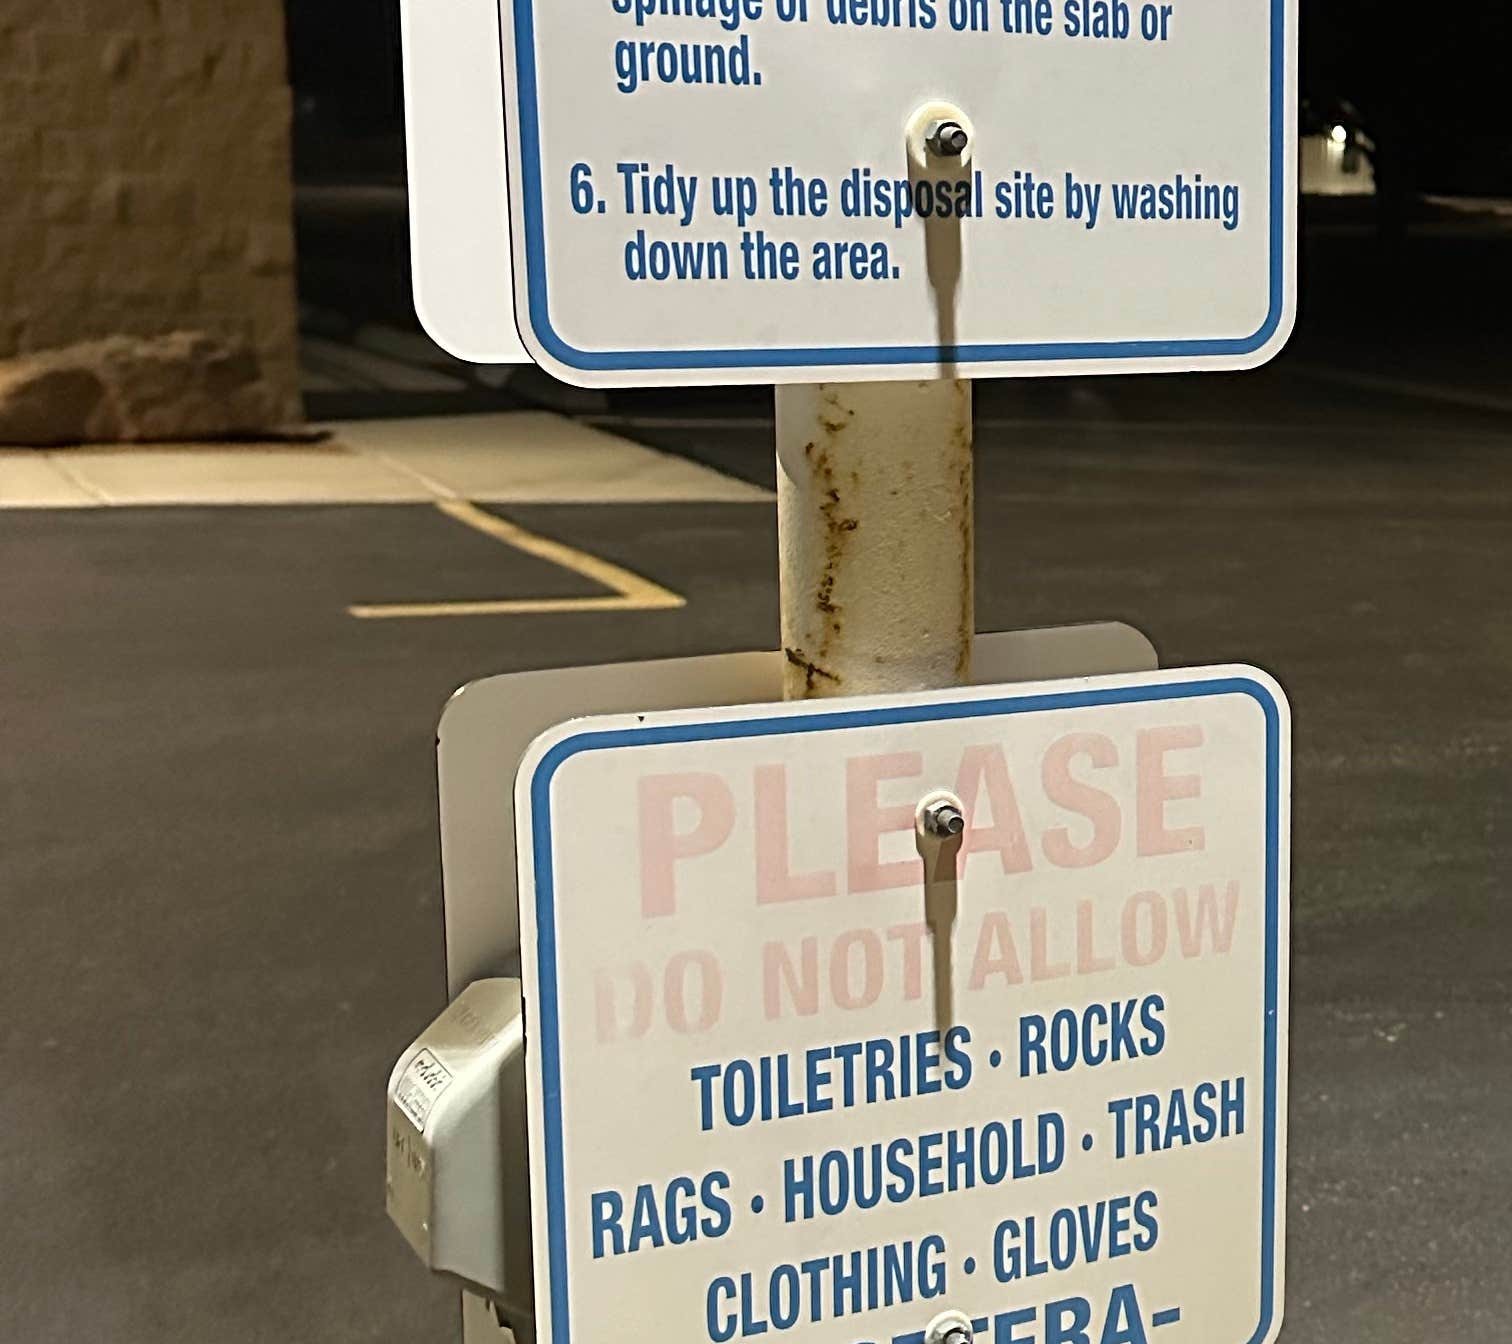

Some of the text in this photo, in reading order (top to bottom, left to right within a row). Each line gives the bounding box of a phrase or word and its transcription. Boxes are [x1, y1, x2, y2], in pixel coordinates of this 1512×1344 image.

[615, 34, 762, 94] ground.
[1140, 3, 1173, 41] or
[570, 162, 1239, 231] 6. Tidy up the disposal site by washing
[624, 229, 900, 281] down the area.
[638, 725, 1205, 920] PLEASE
[593, 948, 725, 1046] DO
[763, 923, 934, 1021] NOT
[966, 881, 1240, 992] ALLOW
[691, 994, 1165, 1131] TOILETRIES ROCKS
[591, 1076, 1245, 1260] RAGS HOUSEHOLD TRASH
[706, 1190, 1158, 1344] CLOTHING GLOVES
